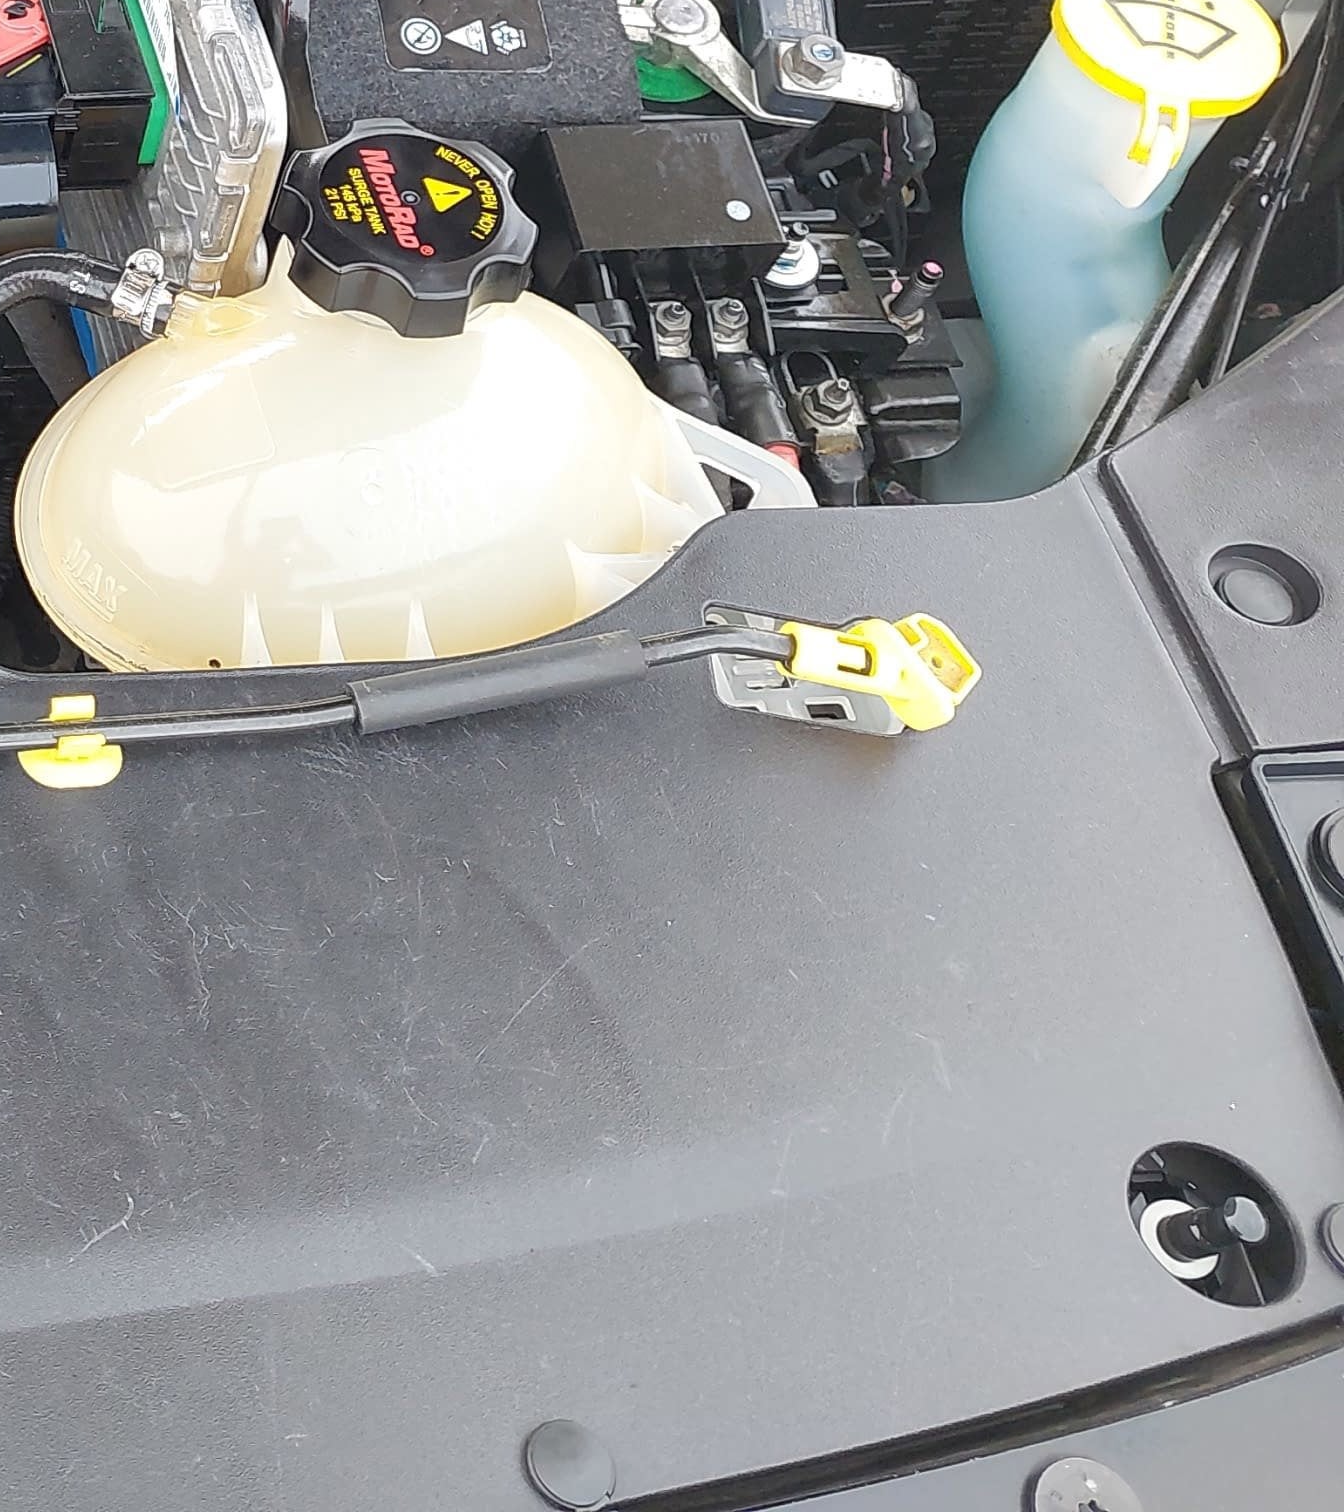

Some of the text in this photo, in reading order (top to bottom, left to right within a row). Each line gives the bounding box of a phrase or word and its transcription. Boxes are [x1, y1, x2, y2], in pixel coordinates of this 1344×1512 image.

[339, 184, 354, 202] 145
[348, 166, 387, 236] SURGE TANK
[435, 144, 481, 180] NEVER
[474, 179, 499, 209] OPEN
[324, 187, 348, 220] 21 PSI
